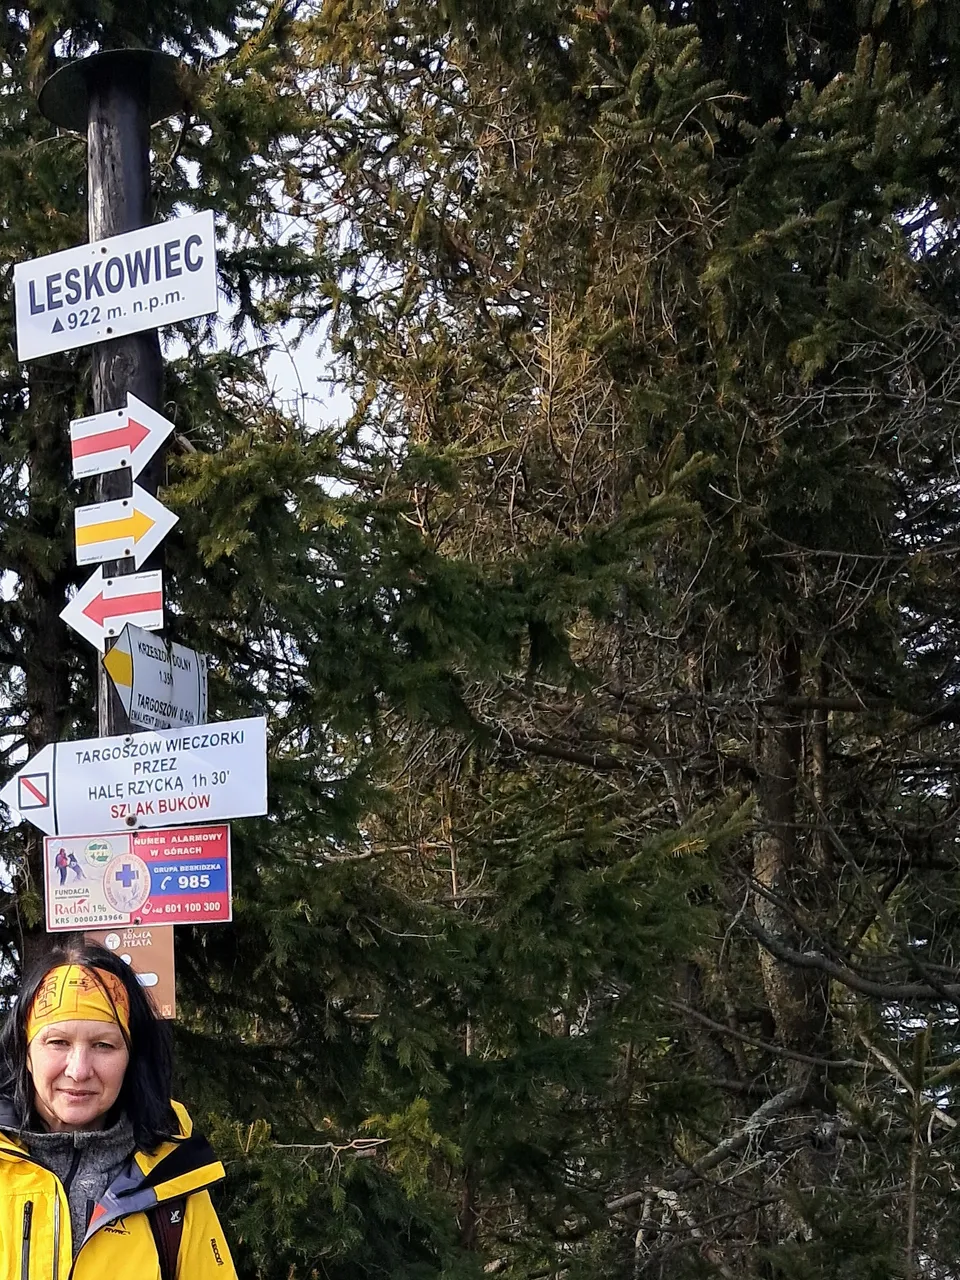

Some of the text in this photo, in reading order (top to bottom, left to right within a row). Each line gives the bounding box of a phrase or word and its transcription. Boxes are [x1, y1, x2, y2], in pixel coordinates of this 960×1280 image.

[29, 234, 204, 316] LESKOWIEC
[67, 289, 186, 330] 922 m. n.p.m.
[137, 693, 179, 719] TARGOSZÓW
[76, 730, 244, 765] TARGOSZÓW WIECZORKI
[133, 757, 178, 776] PRZEZ
[89, 783, 123, 800] HALĘ
[128, 776, 184, 795] RZYCKĄ
[192, 773, 207, 788] 1h
[111, 792, 211, 819] SZLAK BUKÓW
[134, 833, 223, 846] NUMER ALARMOWY
[150, 847, 202, 857] W GÓRACH
[180, 863, 221, 872] BESKIDZKA
[178, 875, 210, 889] 985
[54, 888, 90, 896] FUNDACJA
[92, 904, 107, 913] 1%
[165, 904, 181, 913] 601
[185, 902, 201, 912] 100
[203, 902, 221, 911] 300
[74, 914, 123, 923] 0000283966
